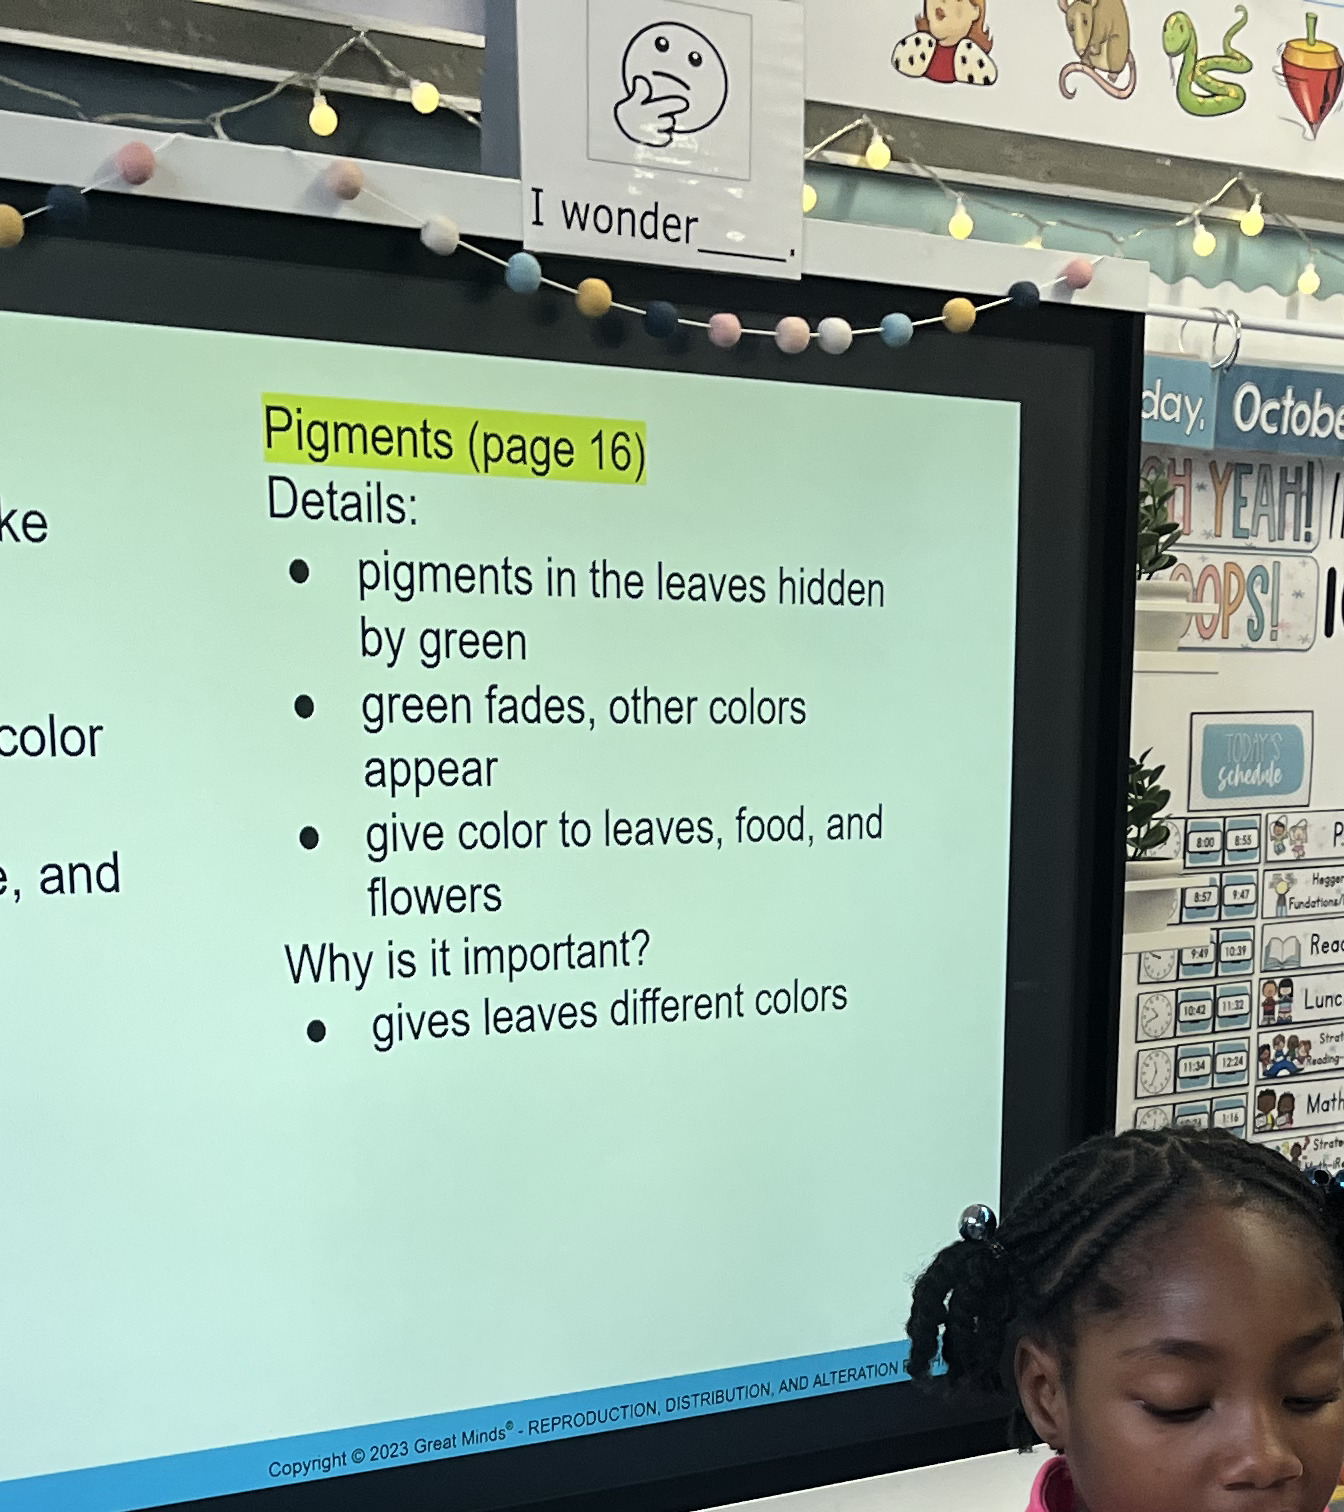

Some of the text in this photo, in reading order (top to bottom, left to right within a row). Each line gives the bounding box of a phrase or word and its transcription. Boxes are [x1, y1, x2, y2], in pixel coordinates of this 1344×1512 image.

[531, 188, 544, 226] I
[265, 405, 645, 483] Pigments (page 16)
[268, 475, 416, 526] Details:
[1209, 459, 1314, 542] YEAH!
[358, 556, 884, 608] pigments in the leaves hidden
[362, 683, 806, 734] green fades, other colors
[1218, 761, 1283, 791] schedule
[366, 803, 883, 863] give color to leaves, food, and
[40, 850, 120, 895] and
[1183, 1056, 1243, 1072] 11:34 12:24
[268, 1450, 347, 1480] Copyright
[370, 1441, 409, 1461] 2023
[414, 1433, 457, 1454] Great
[528, 1401, 660, 1438] REPRODUCTION,
[665, 1382, 775, 1414] DISTRIBUTION,
[779, 1374, 808, 1395] AND
[812, 1360, 900, 1389] ALTERATION
